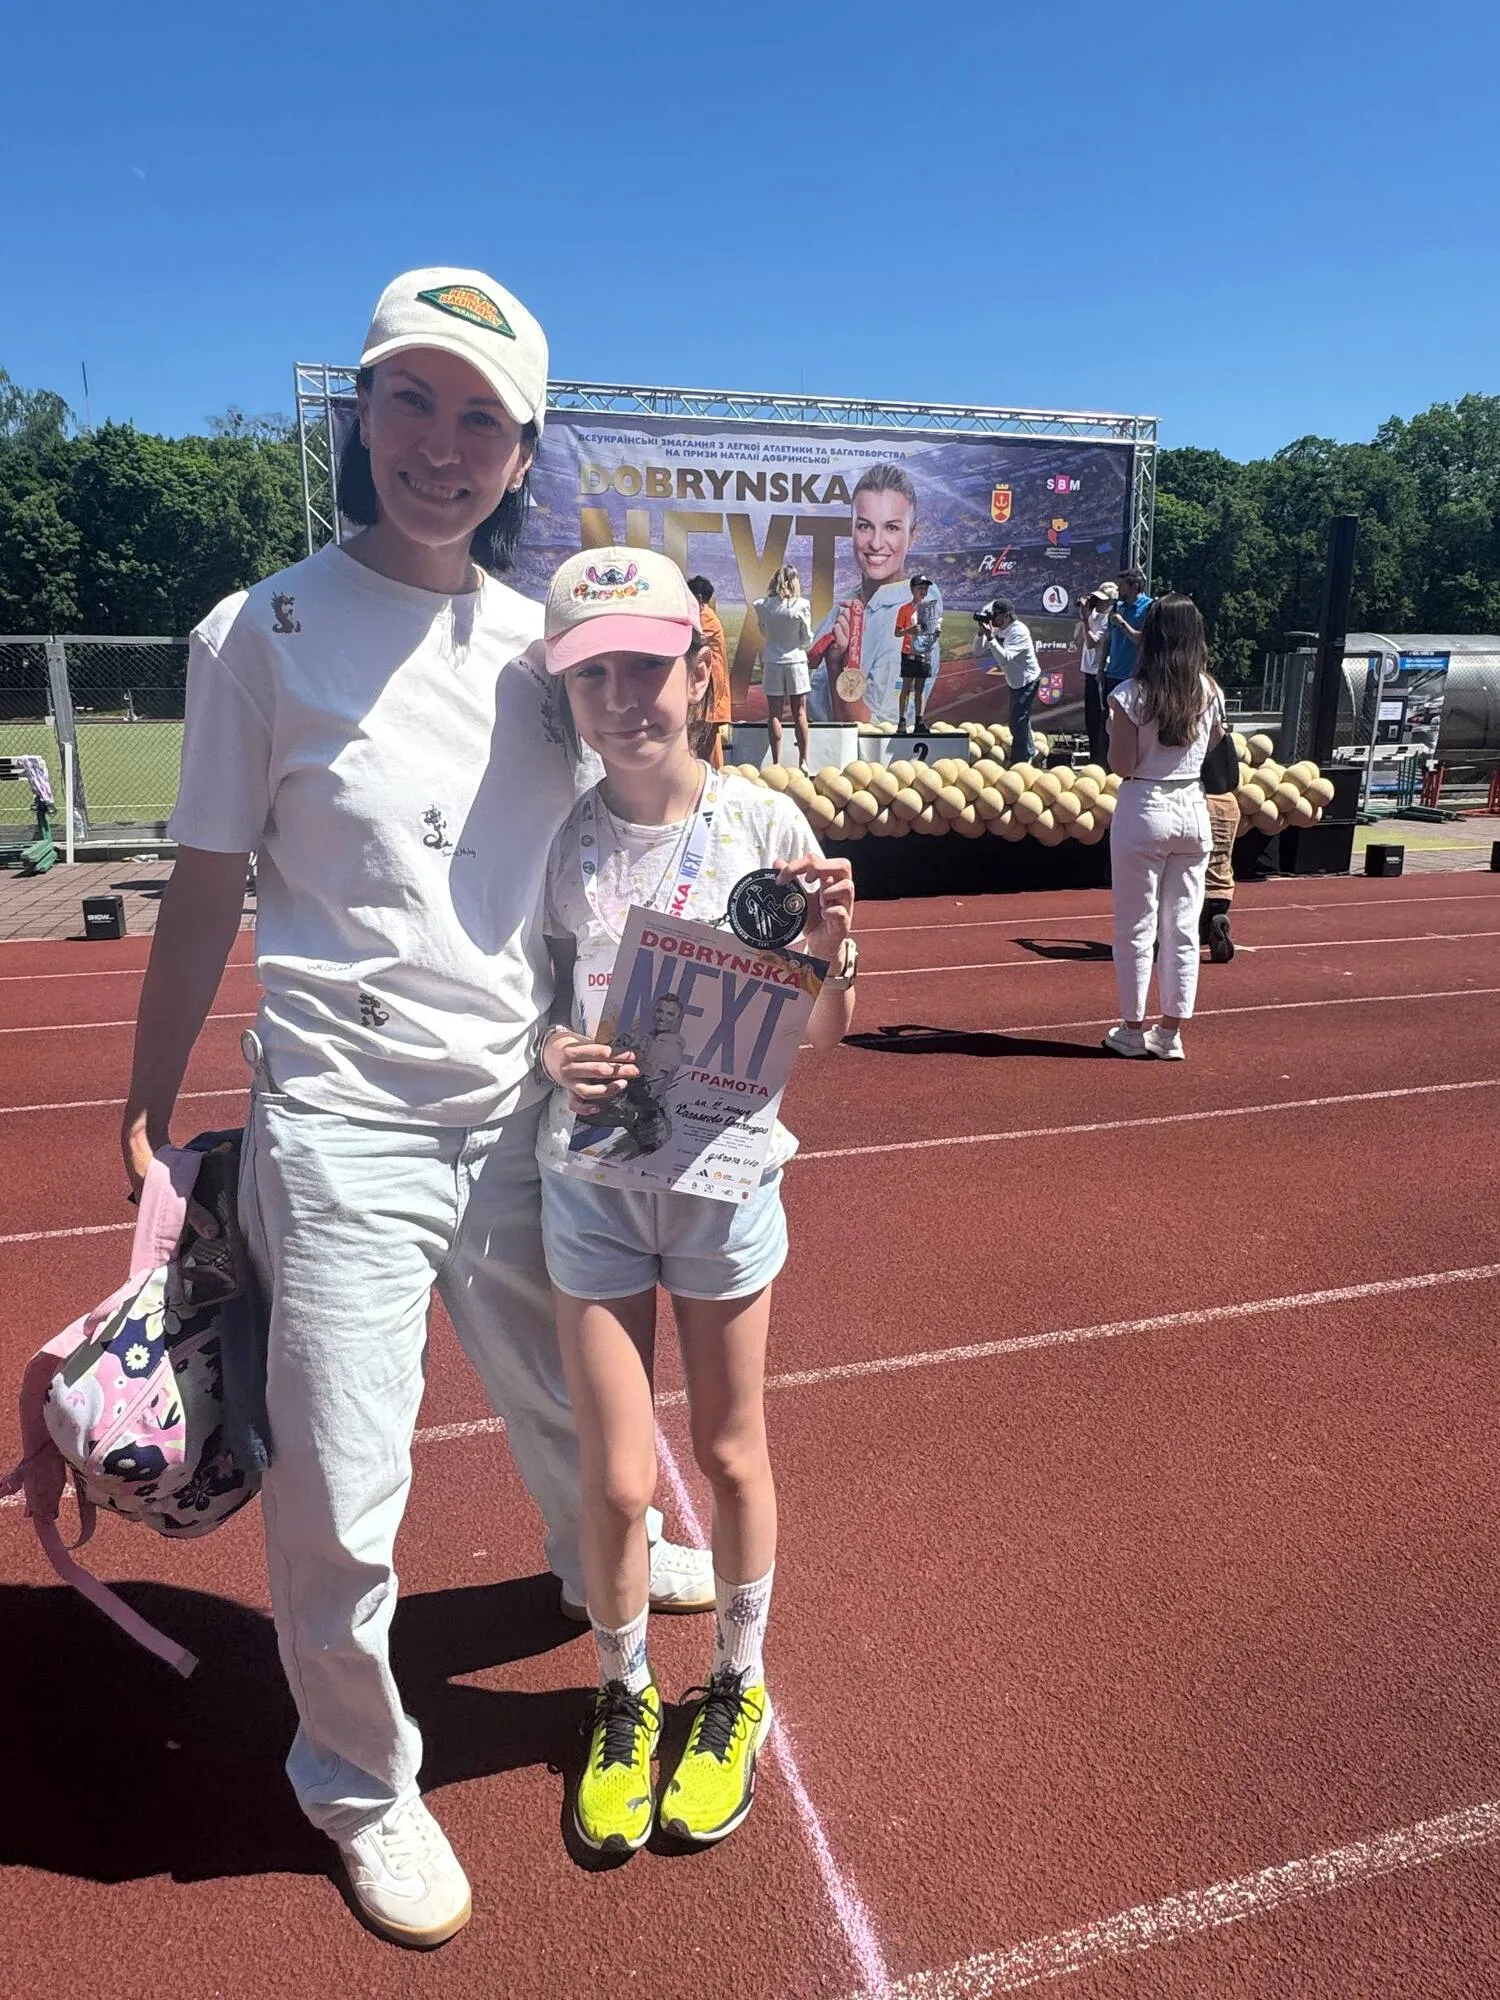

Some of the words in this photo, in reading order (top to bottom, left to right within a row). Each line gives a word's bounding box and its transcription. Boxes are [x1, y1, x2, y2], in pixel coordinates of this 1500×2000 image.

[578, 433, 658, 446] ВСЕУКРАЇНСЬКІ
[661, 438, 716, 449] ЗМАГАННЯ
[718, 442, 724, 450] З
[727, 442, 760, 452] ЛЕГКОЇ
[763, 444, 813, 454] АТЛЕТИКИ
[816, 447, 828, 455] ТА
[830, 447, 906, 460] БАГАТОБОРСТВА
[665, 448, 681, 457] НА
[683, 449, 718, 459] ПРИЗИ
[721, 450, 760, 462] НАТАЛІЇ
[761, 453, 831, 465] ДОБРИНСЬКОЇ
[580, 463, 852, 505] DOBRYNSKA
[1046, 478, 1081, 491] SBM
[680, 851, 704, 879] NEXT
[640, 929, 801, 989] DOBRYNSKA
[615, 947, 800, 1081] NEXT
[690, 1071, 769, 1098] ГРАМОТА
